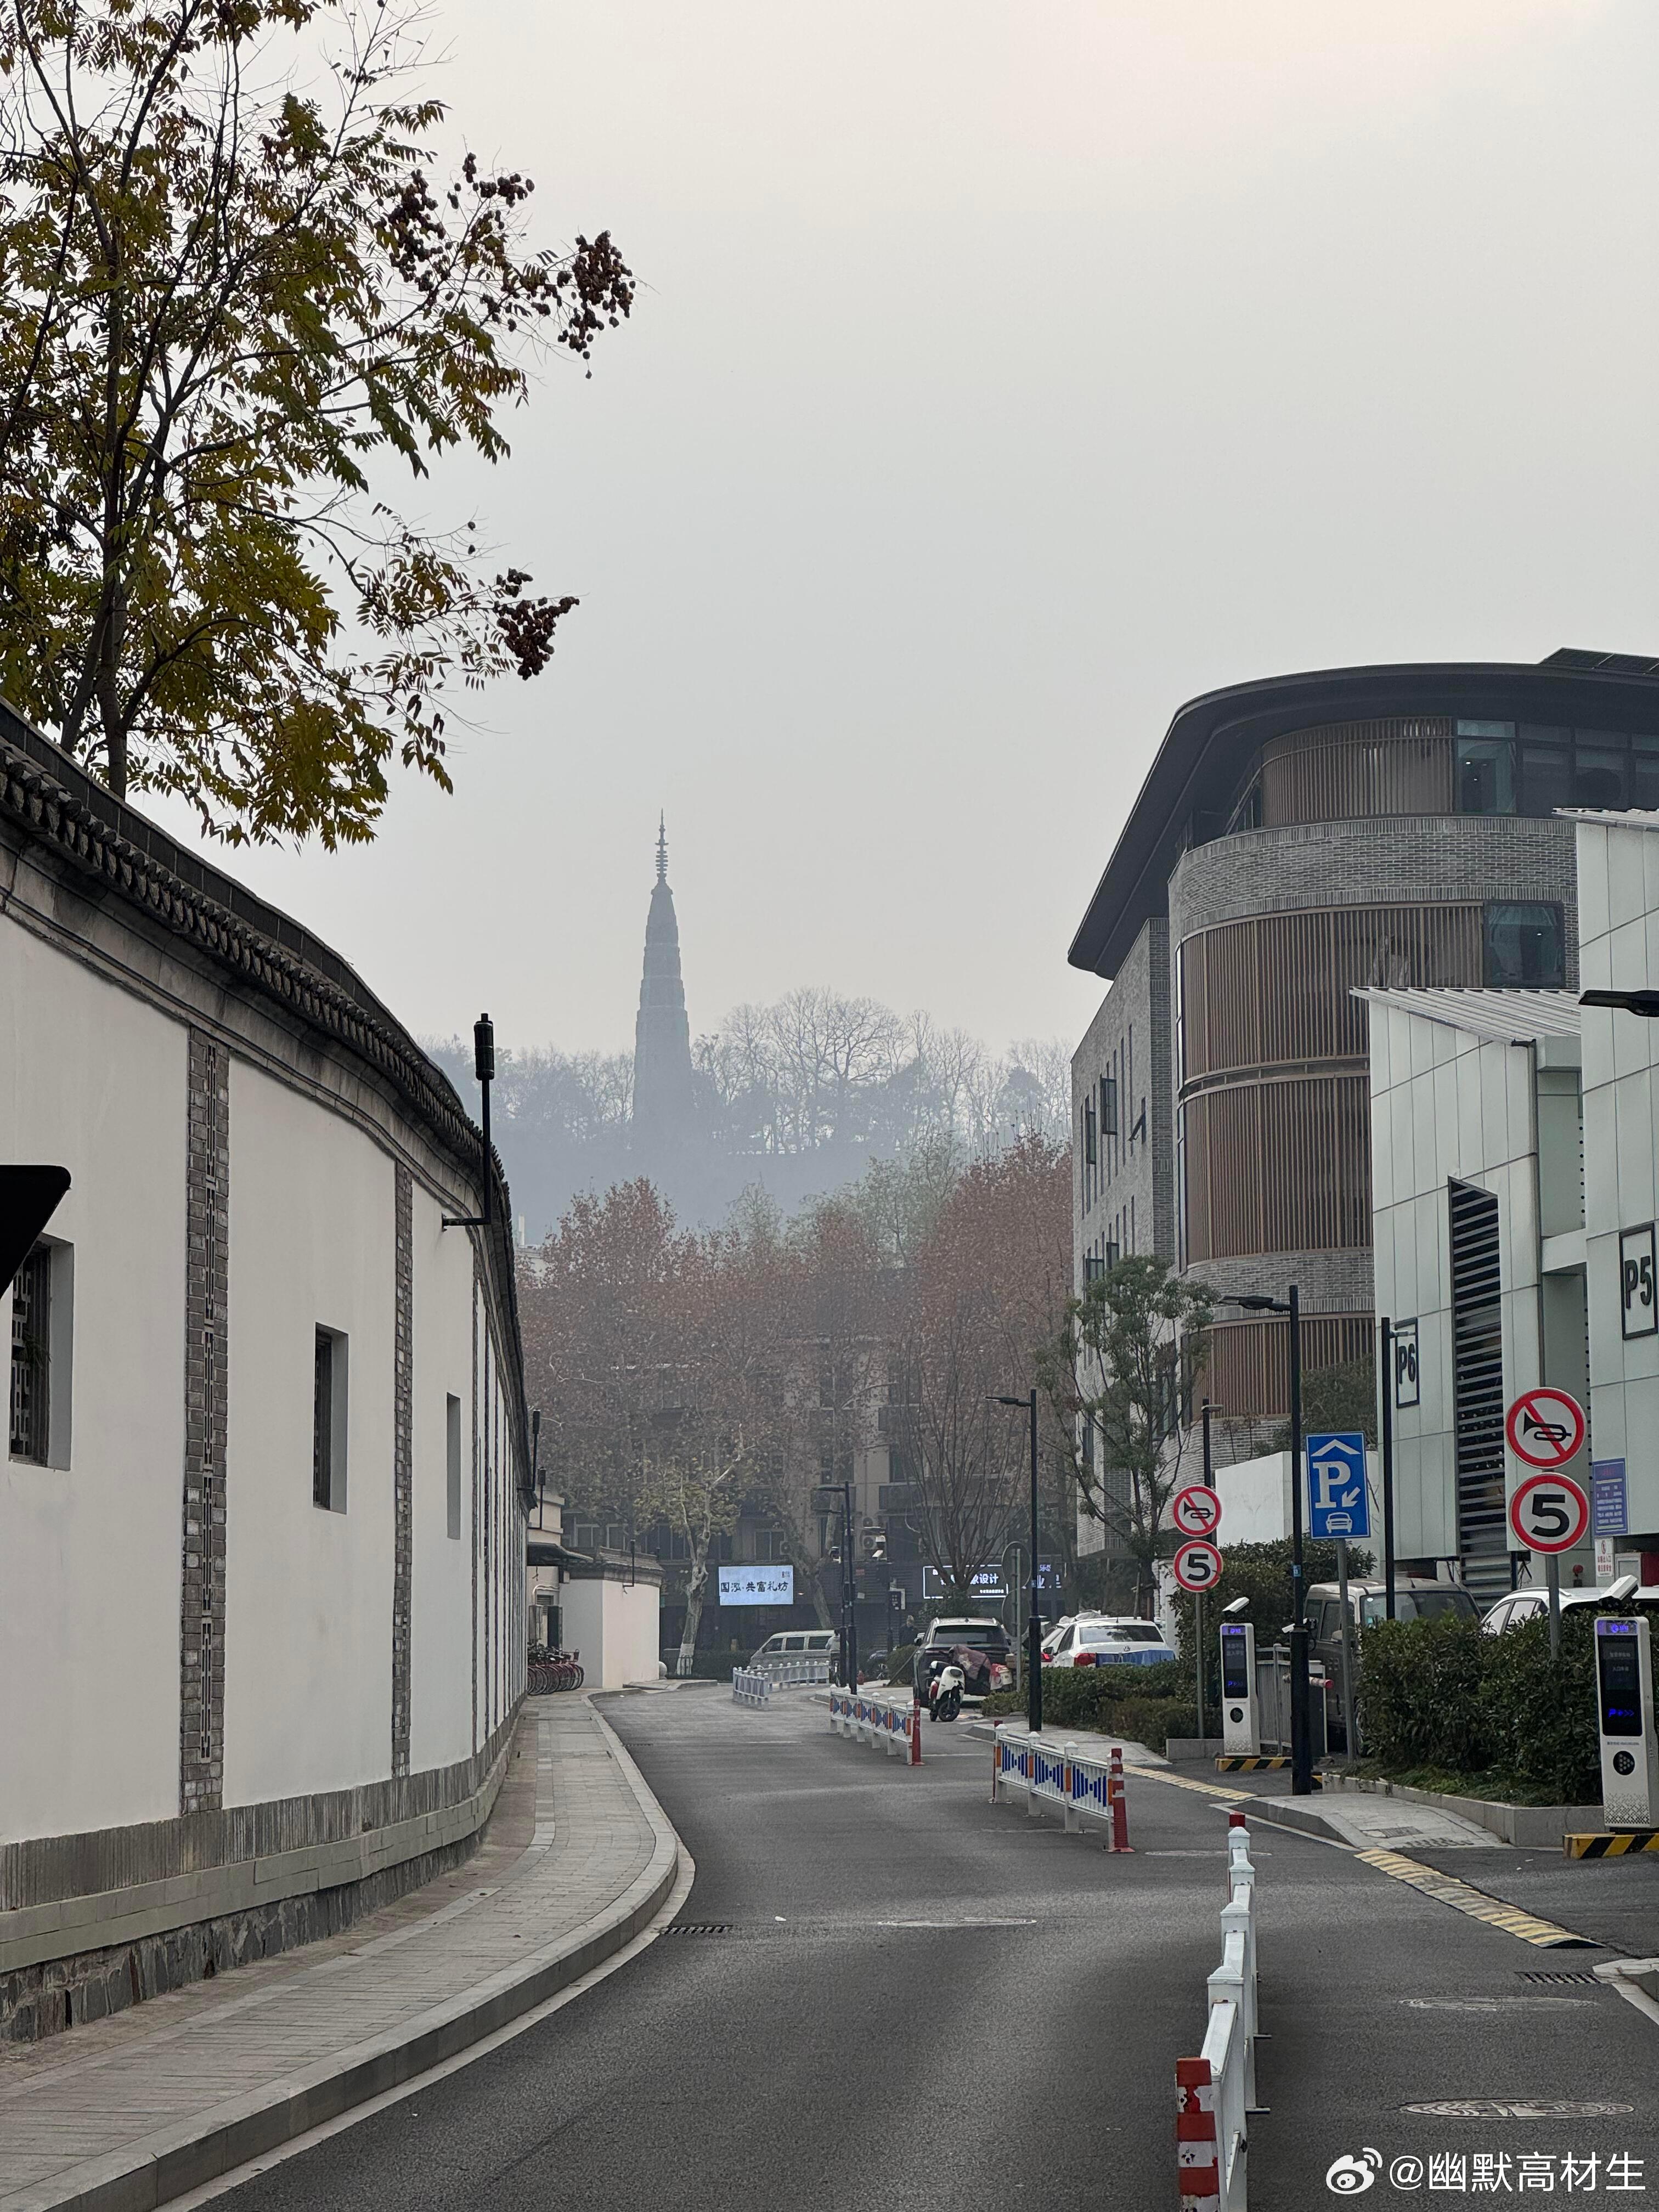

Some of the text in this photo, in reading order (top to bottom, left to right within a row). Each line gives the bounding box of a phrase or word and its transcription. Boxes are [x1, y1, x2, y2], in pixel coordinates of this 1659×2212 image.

[1624, 1255, 1652, 1310] P5
[1397, 1342, 1417, 1385] P6
[1312, 1460, 1351, 1509] P
[1531, 1494, 1570, 1538] 5
[1187, 1553, 1211, 1582] 5
